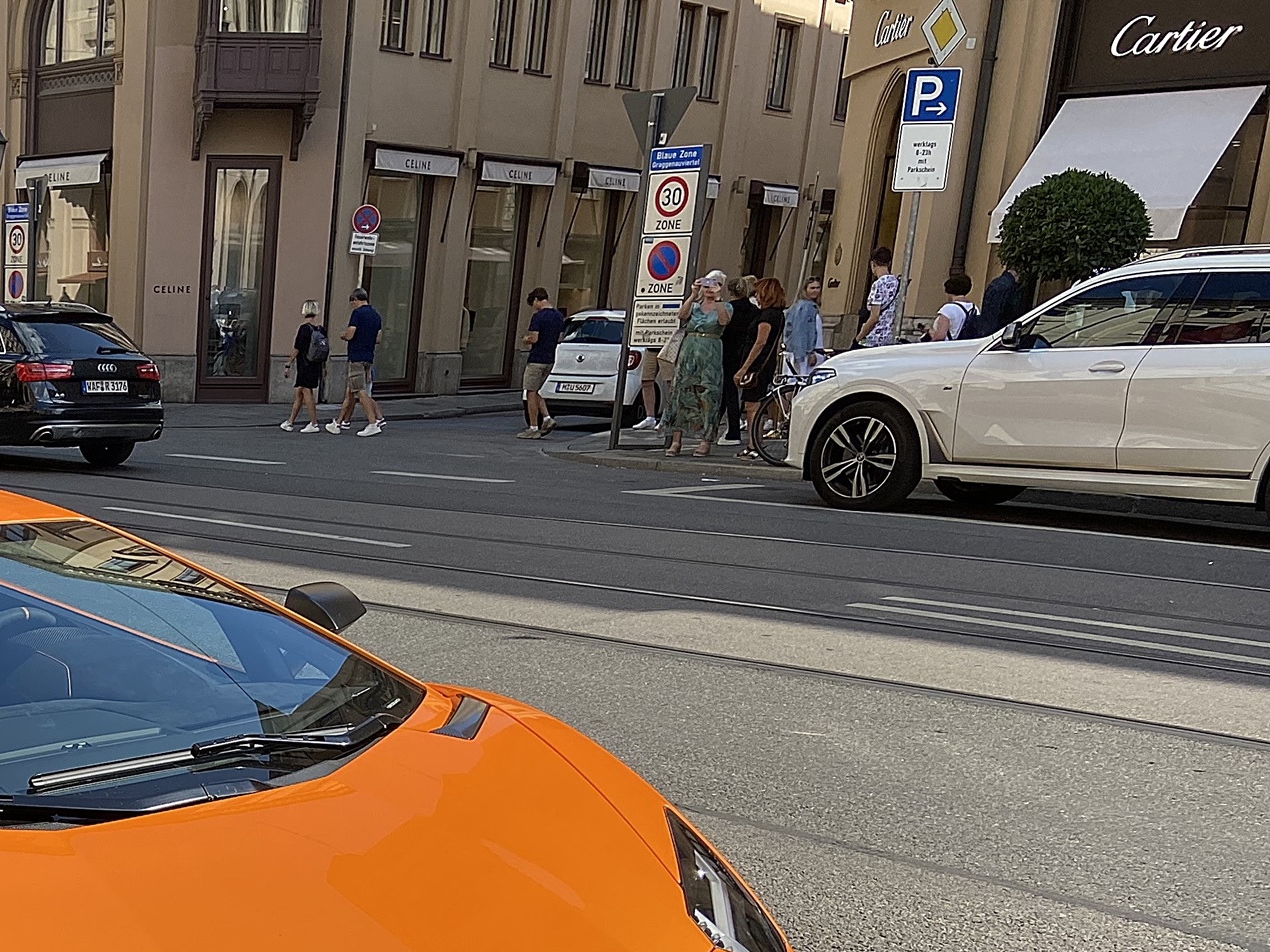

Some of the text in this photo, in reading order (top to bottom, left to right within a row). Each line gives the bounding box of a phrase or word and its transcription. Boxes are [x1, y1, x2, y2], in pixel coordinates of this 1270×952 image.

[874, 10, 913, 48] Cartier
[1110, 15, 1243, 57] Cartier
[912, 76, 943, 116] P
[656, 150, 698, 160] Blaue Zone
[405, 159, 431, 170] CELINE
[44, 171, 70, 182] ELINE
[509, 170, 532, 180] CELINE
[605, 177, 626, 187] CELINE
[662, 187, 682, 206] 30
[655, 219, 682, 230] ZONE
[12, 233, 22, 246] 30
[153, 285, 191, 294] CELINE
[648, 283, 674, 293] ZONE
[111, 381, 128, 391] 3176
